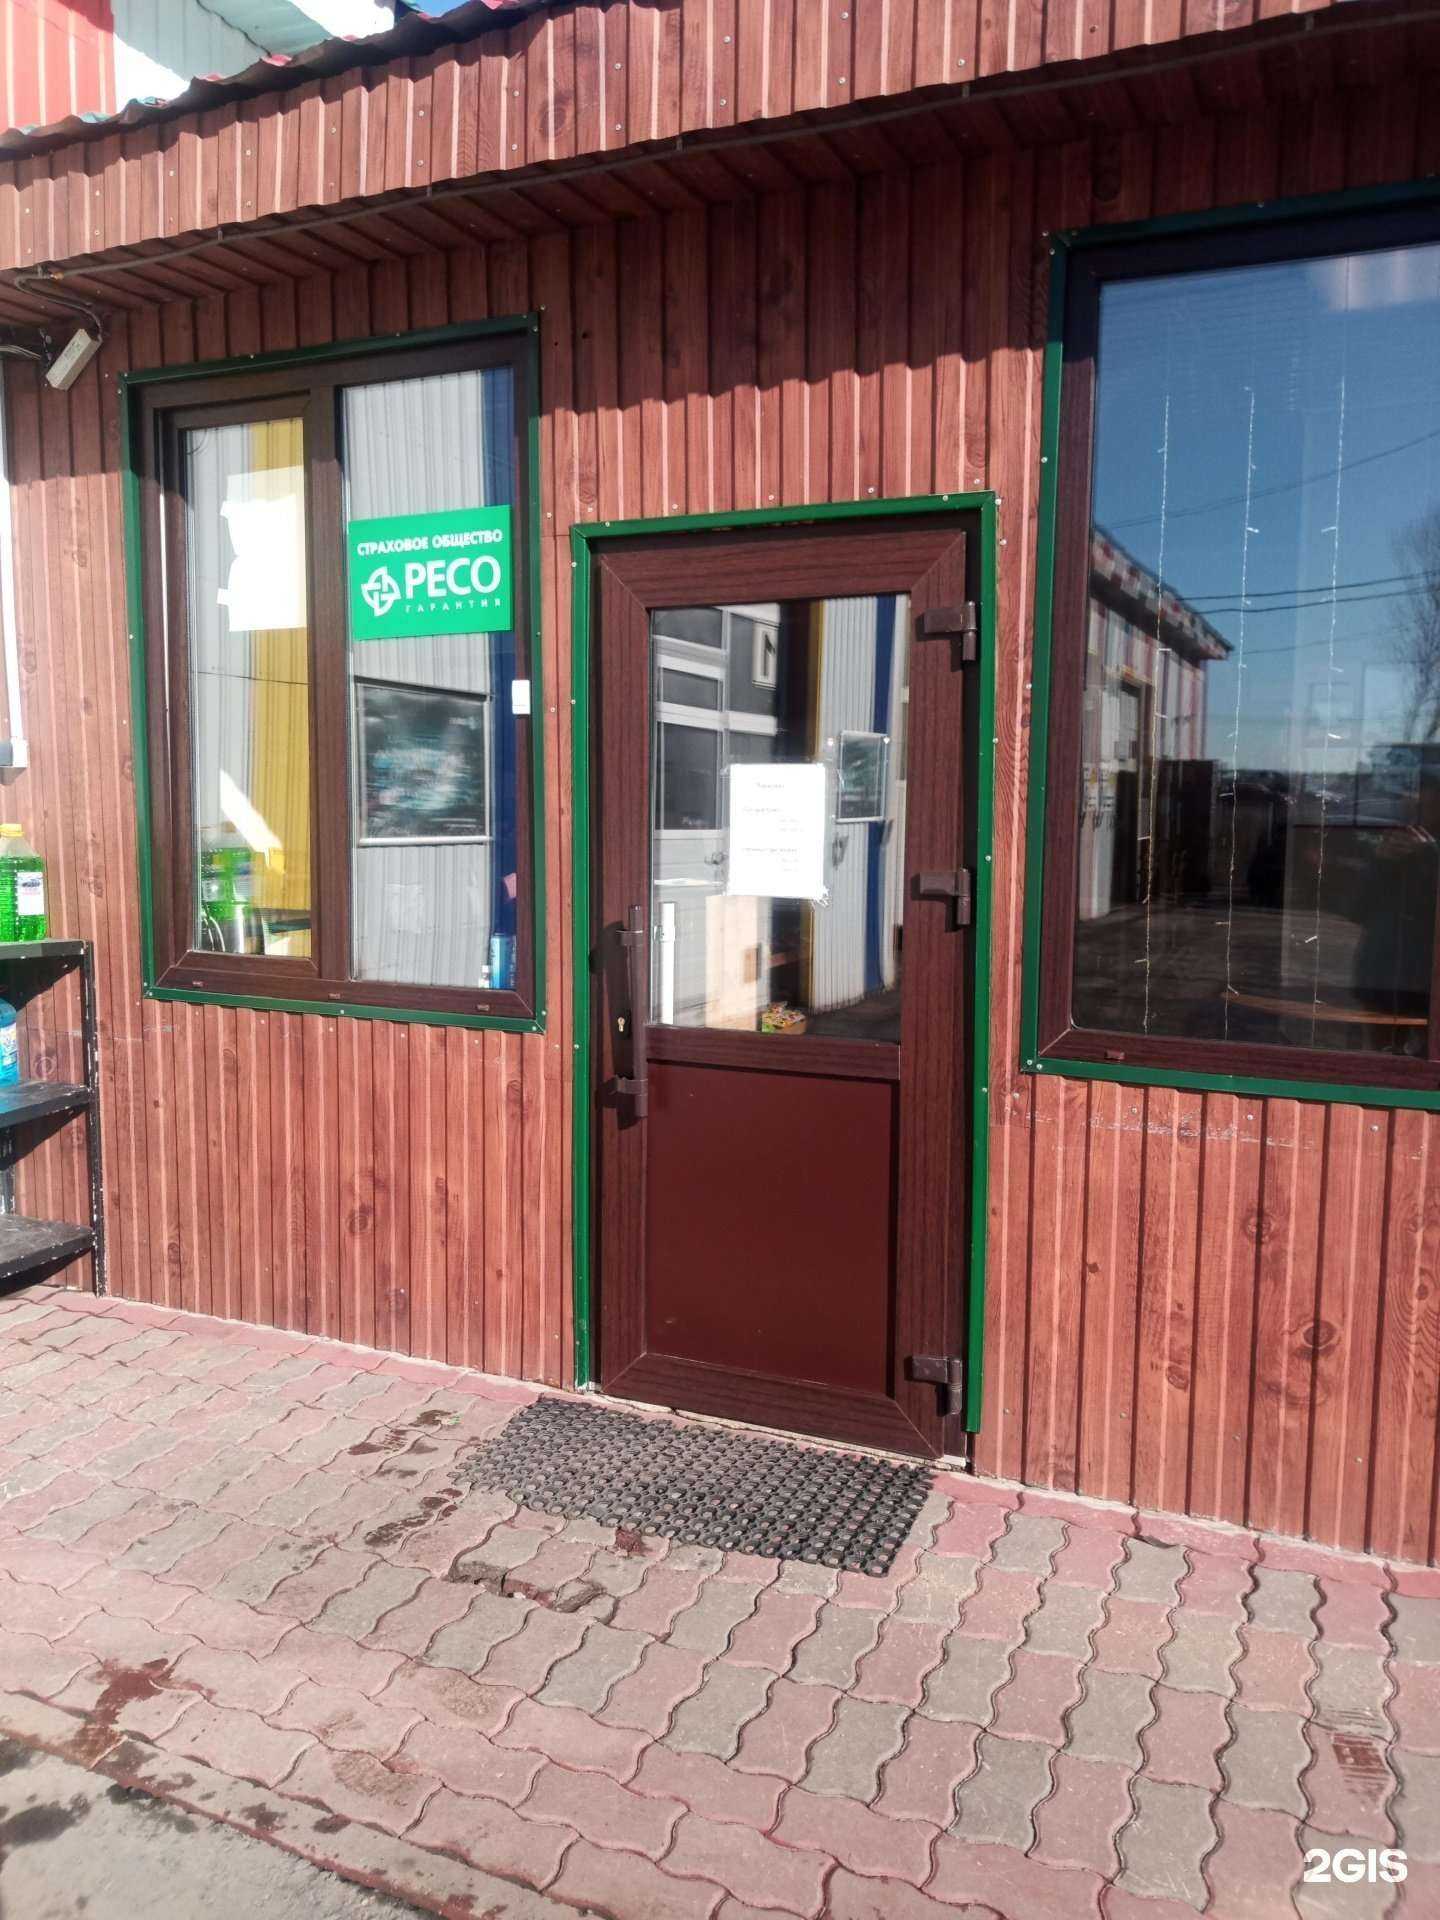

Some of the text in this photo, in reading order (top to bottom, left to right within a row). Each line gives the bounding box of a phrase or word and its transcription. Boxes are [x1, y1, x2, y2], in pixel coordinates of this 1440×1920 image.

[357, 528, 503, 556] СТРАХОВОЕ ОБЩЕСТВО
[404, 555, 501, 600] РЕСО
[405, 598, 503, 613] ГАРАНТИЯ
